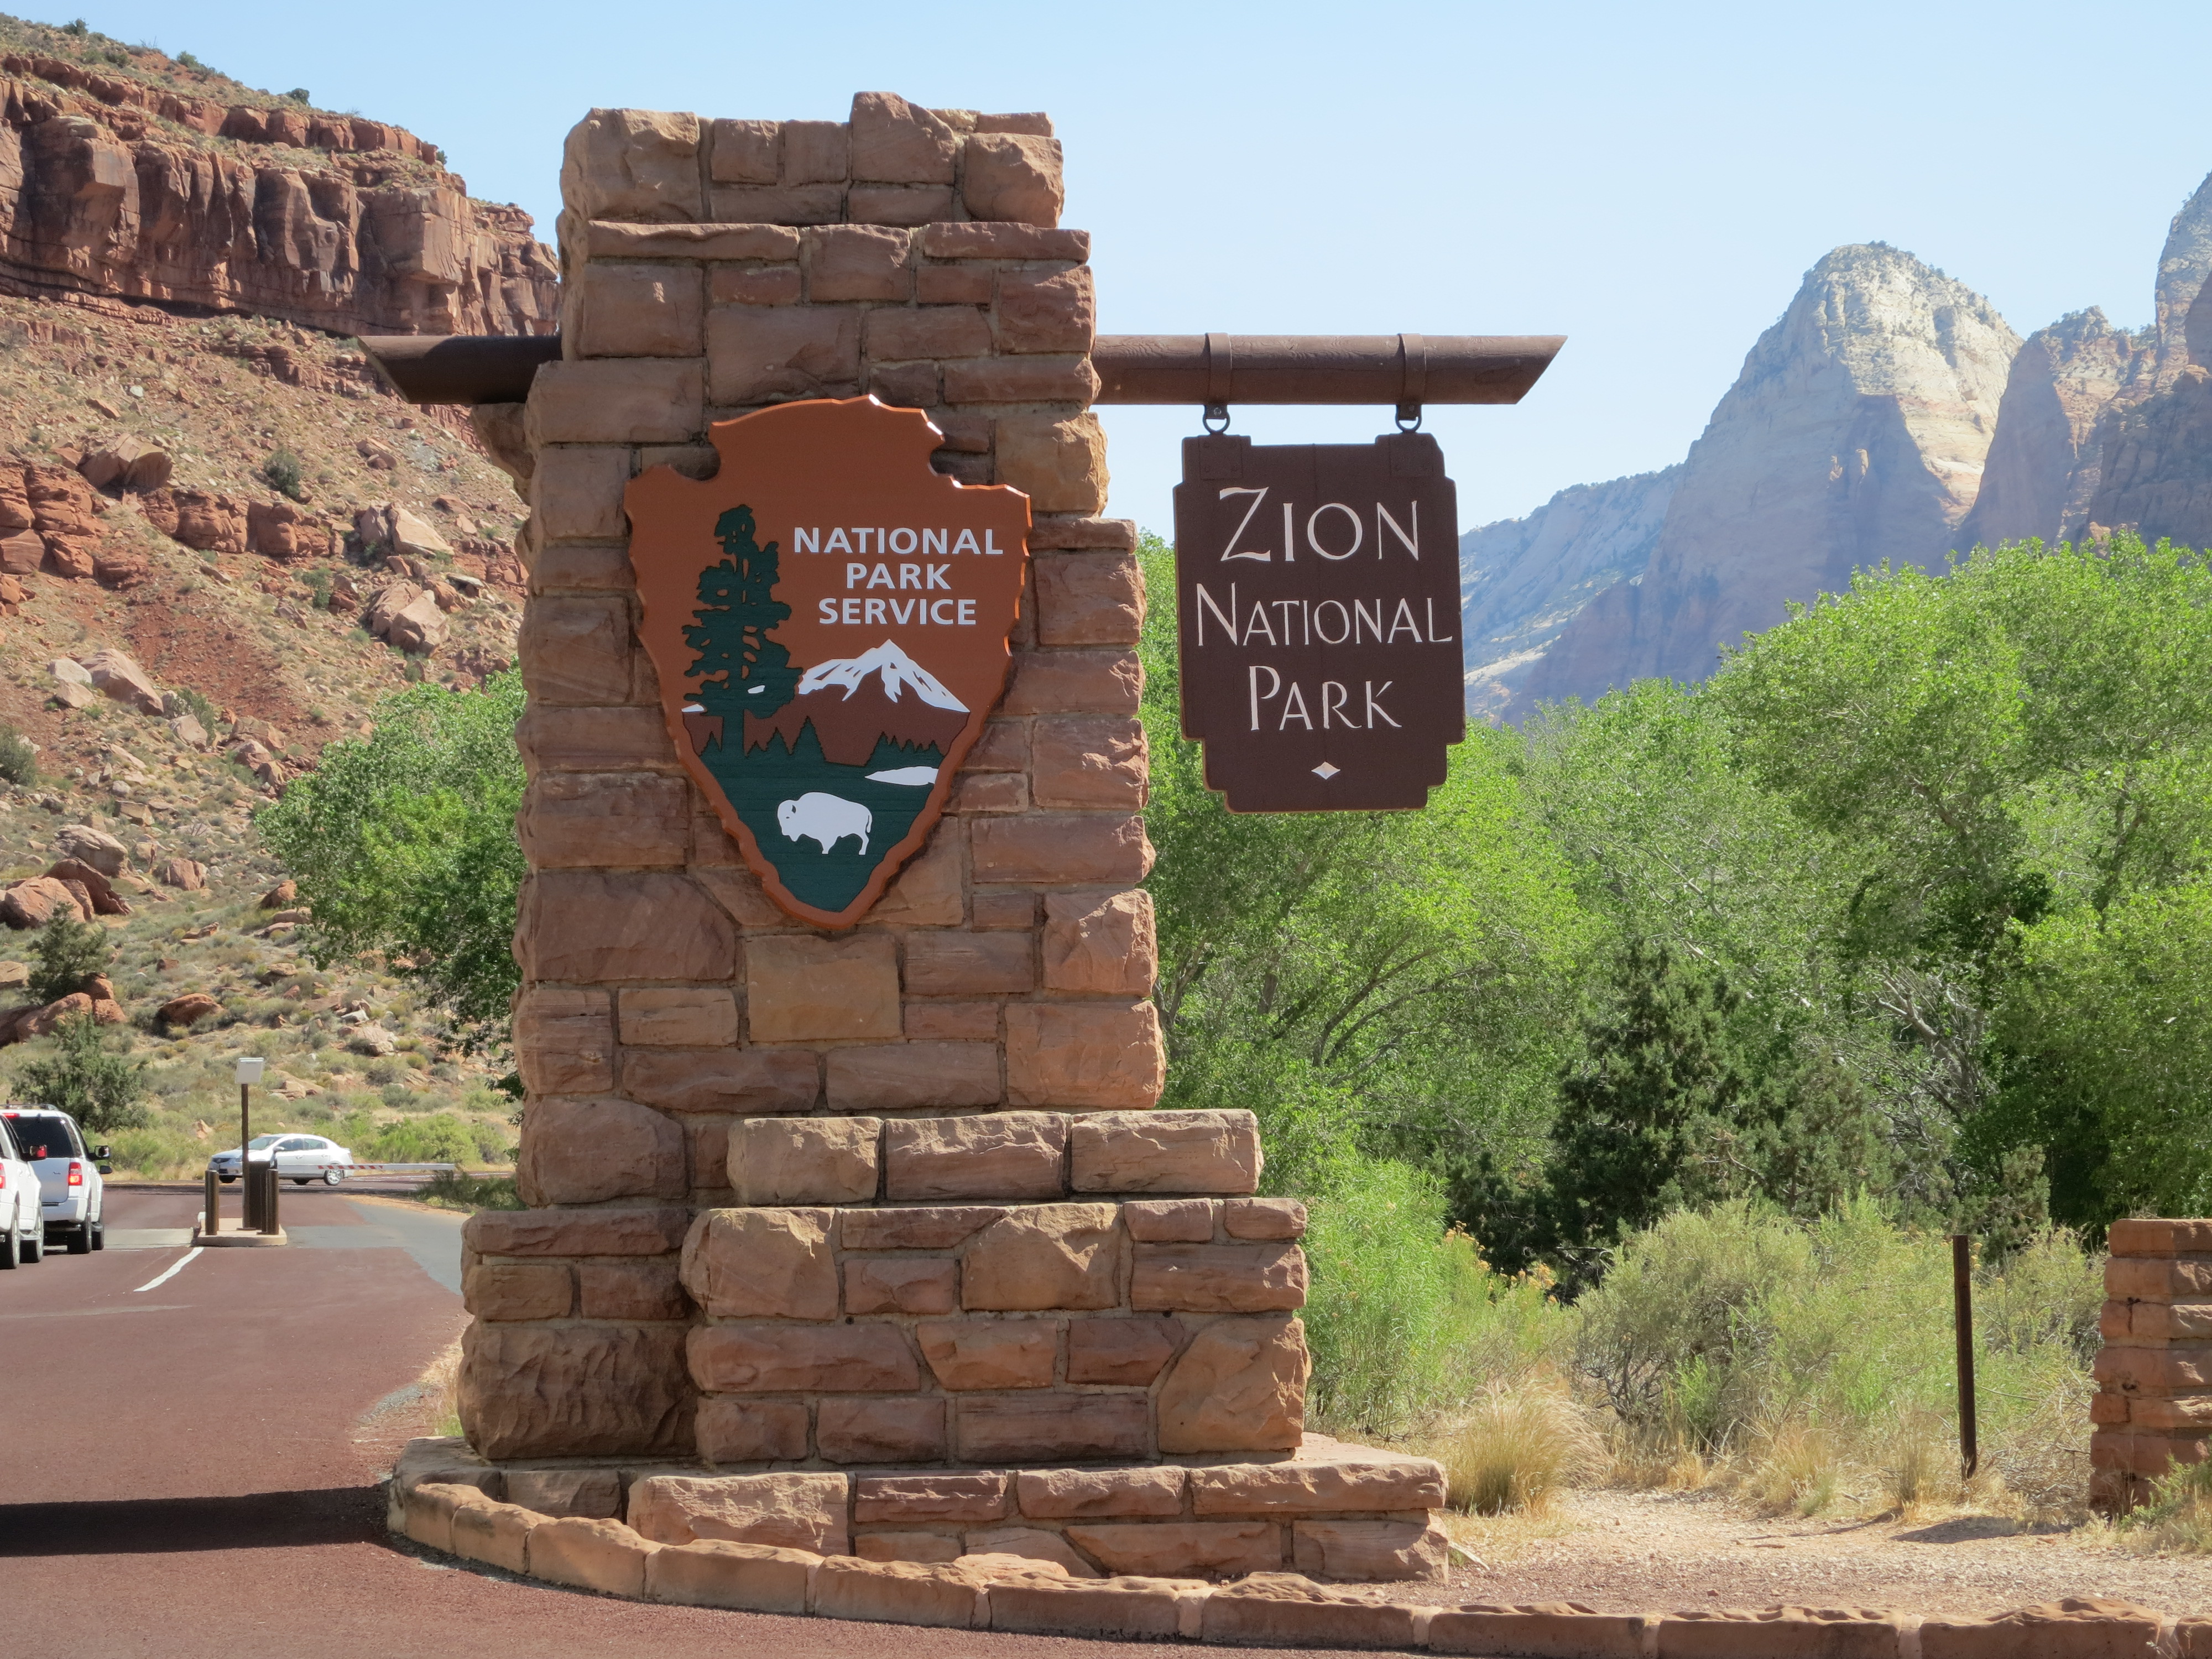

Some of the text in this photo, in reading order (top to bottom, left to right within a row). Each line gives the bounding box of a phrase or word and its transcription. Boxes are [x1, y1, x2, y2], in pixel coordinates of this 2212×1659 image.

[795, 528, 1003, 554] NATIONAL
[1220, 487, 1418, 561] ZION
[847, 563, 951, 589] PARK
[819, 598, 975, 625] SERVICE
[1197, 582, 1452, 646] NATIONAL
[1249, 666, 1402, 731] PARK
